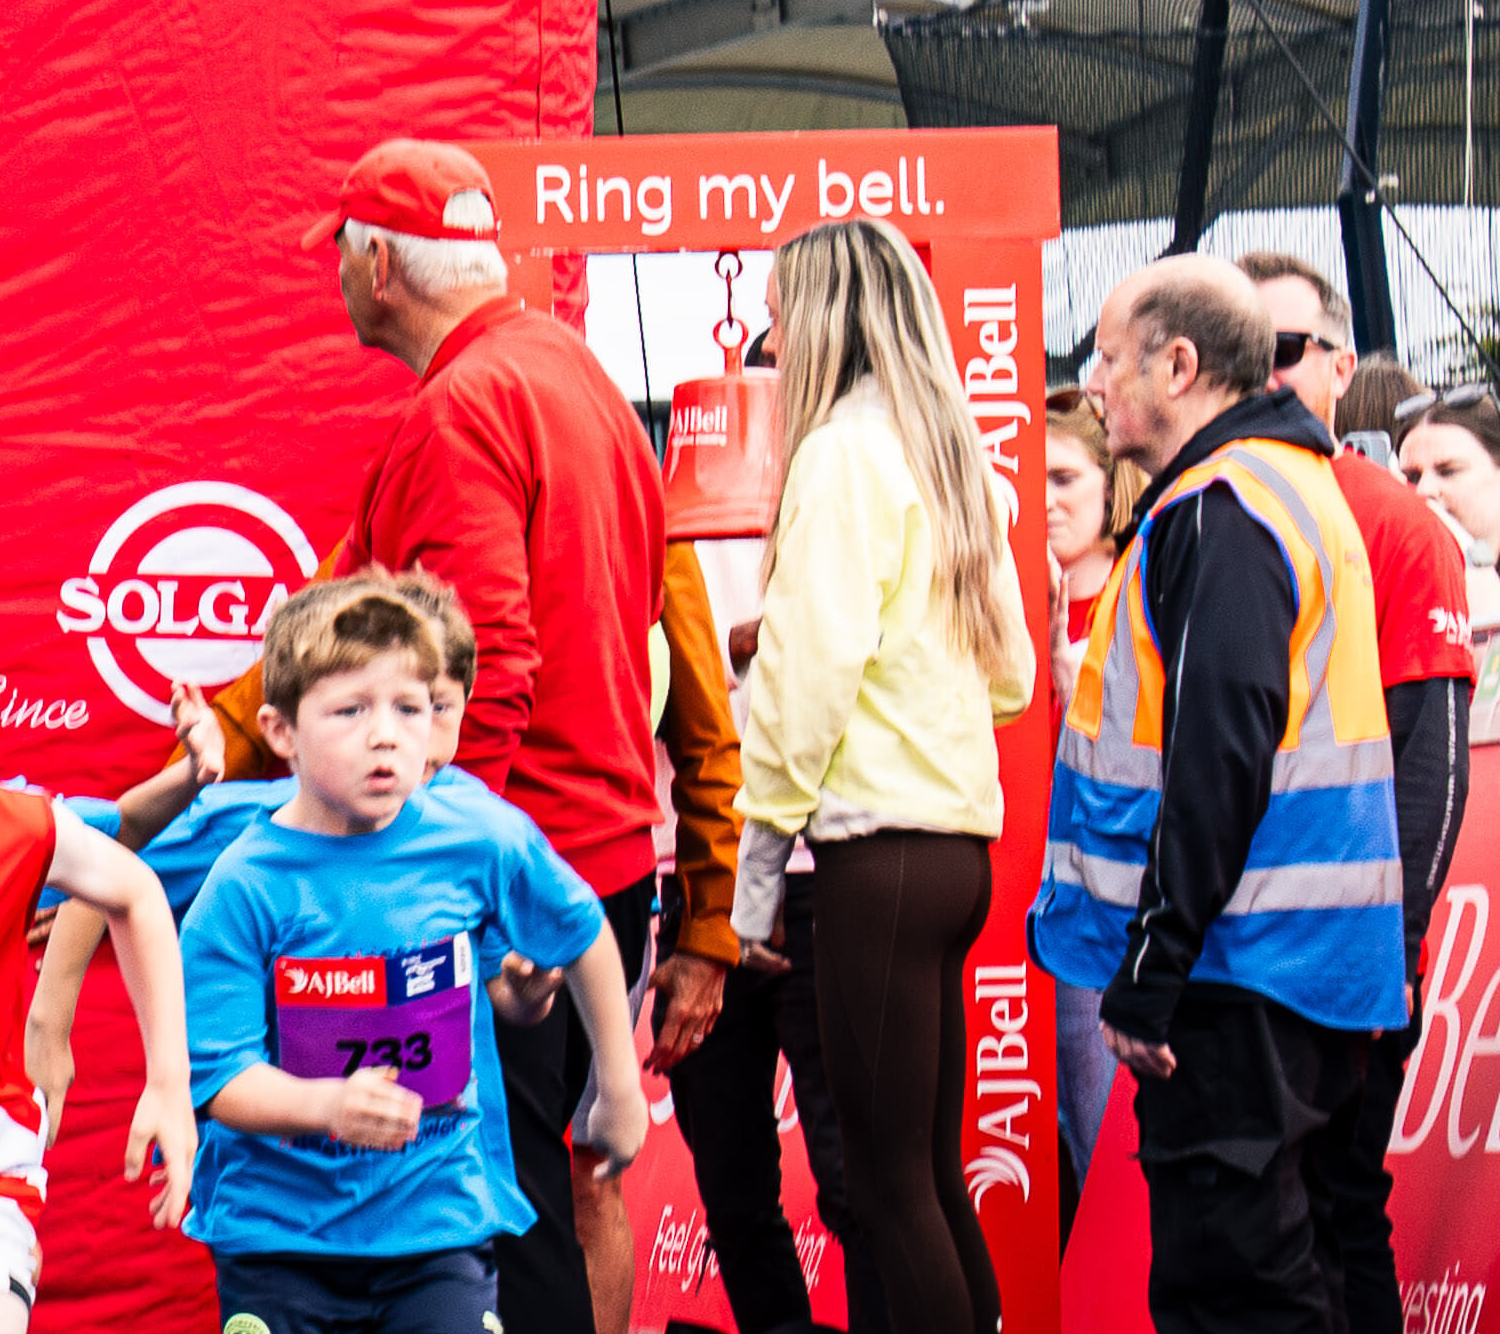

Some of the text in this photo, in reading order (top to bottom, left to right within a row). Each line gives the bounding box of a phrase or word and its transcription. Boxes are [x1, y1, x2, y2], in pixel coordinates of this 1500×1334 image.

[535, 157, 945, 235] Ring my bell.
[335, 1032, 433, 1078] 733
